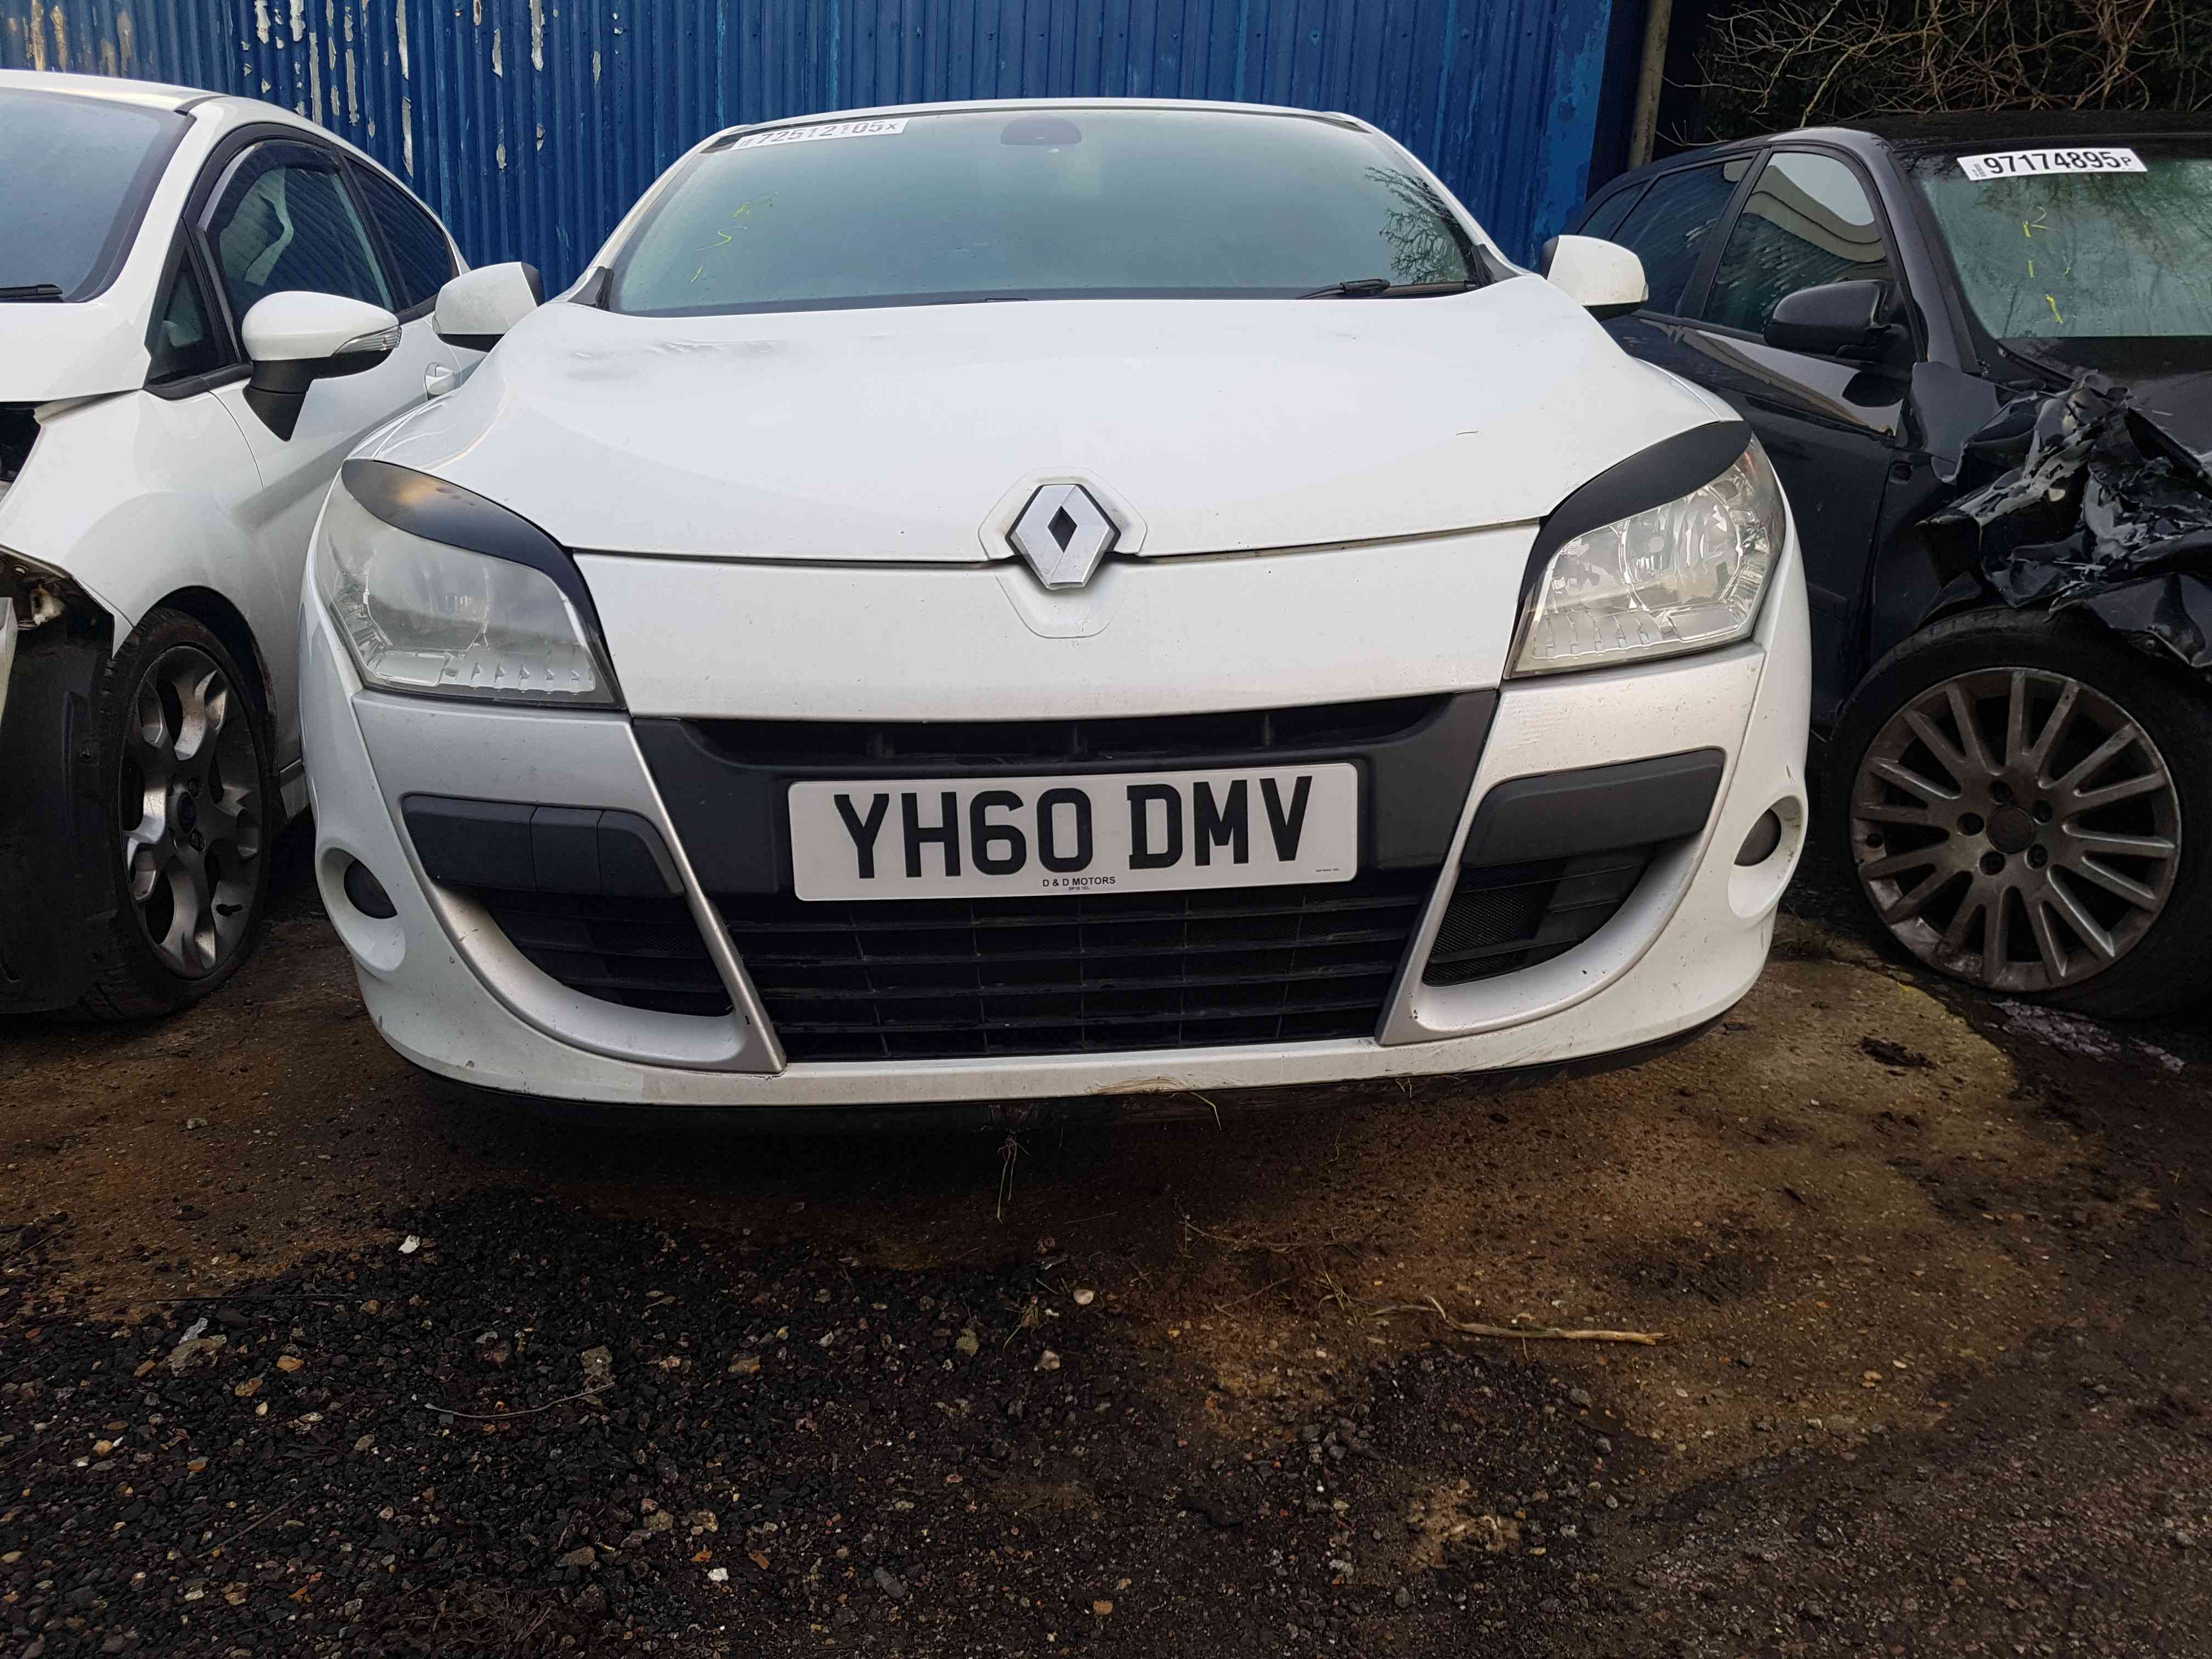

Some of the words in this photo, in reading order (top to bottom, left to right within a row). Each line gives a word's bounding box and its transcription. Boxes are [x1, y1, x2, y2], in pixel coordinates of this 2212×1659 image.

[833, 787, 1094, 879] YH60
[1126, 775, 1313, 871] DMV
[1042, 879, 1049, 887] D
[1062, 878, 1069, 887] D
[1072, 876, 1116, 885] MOTORS
